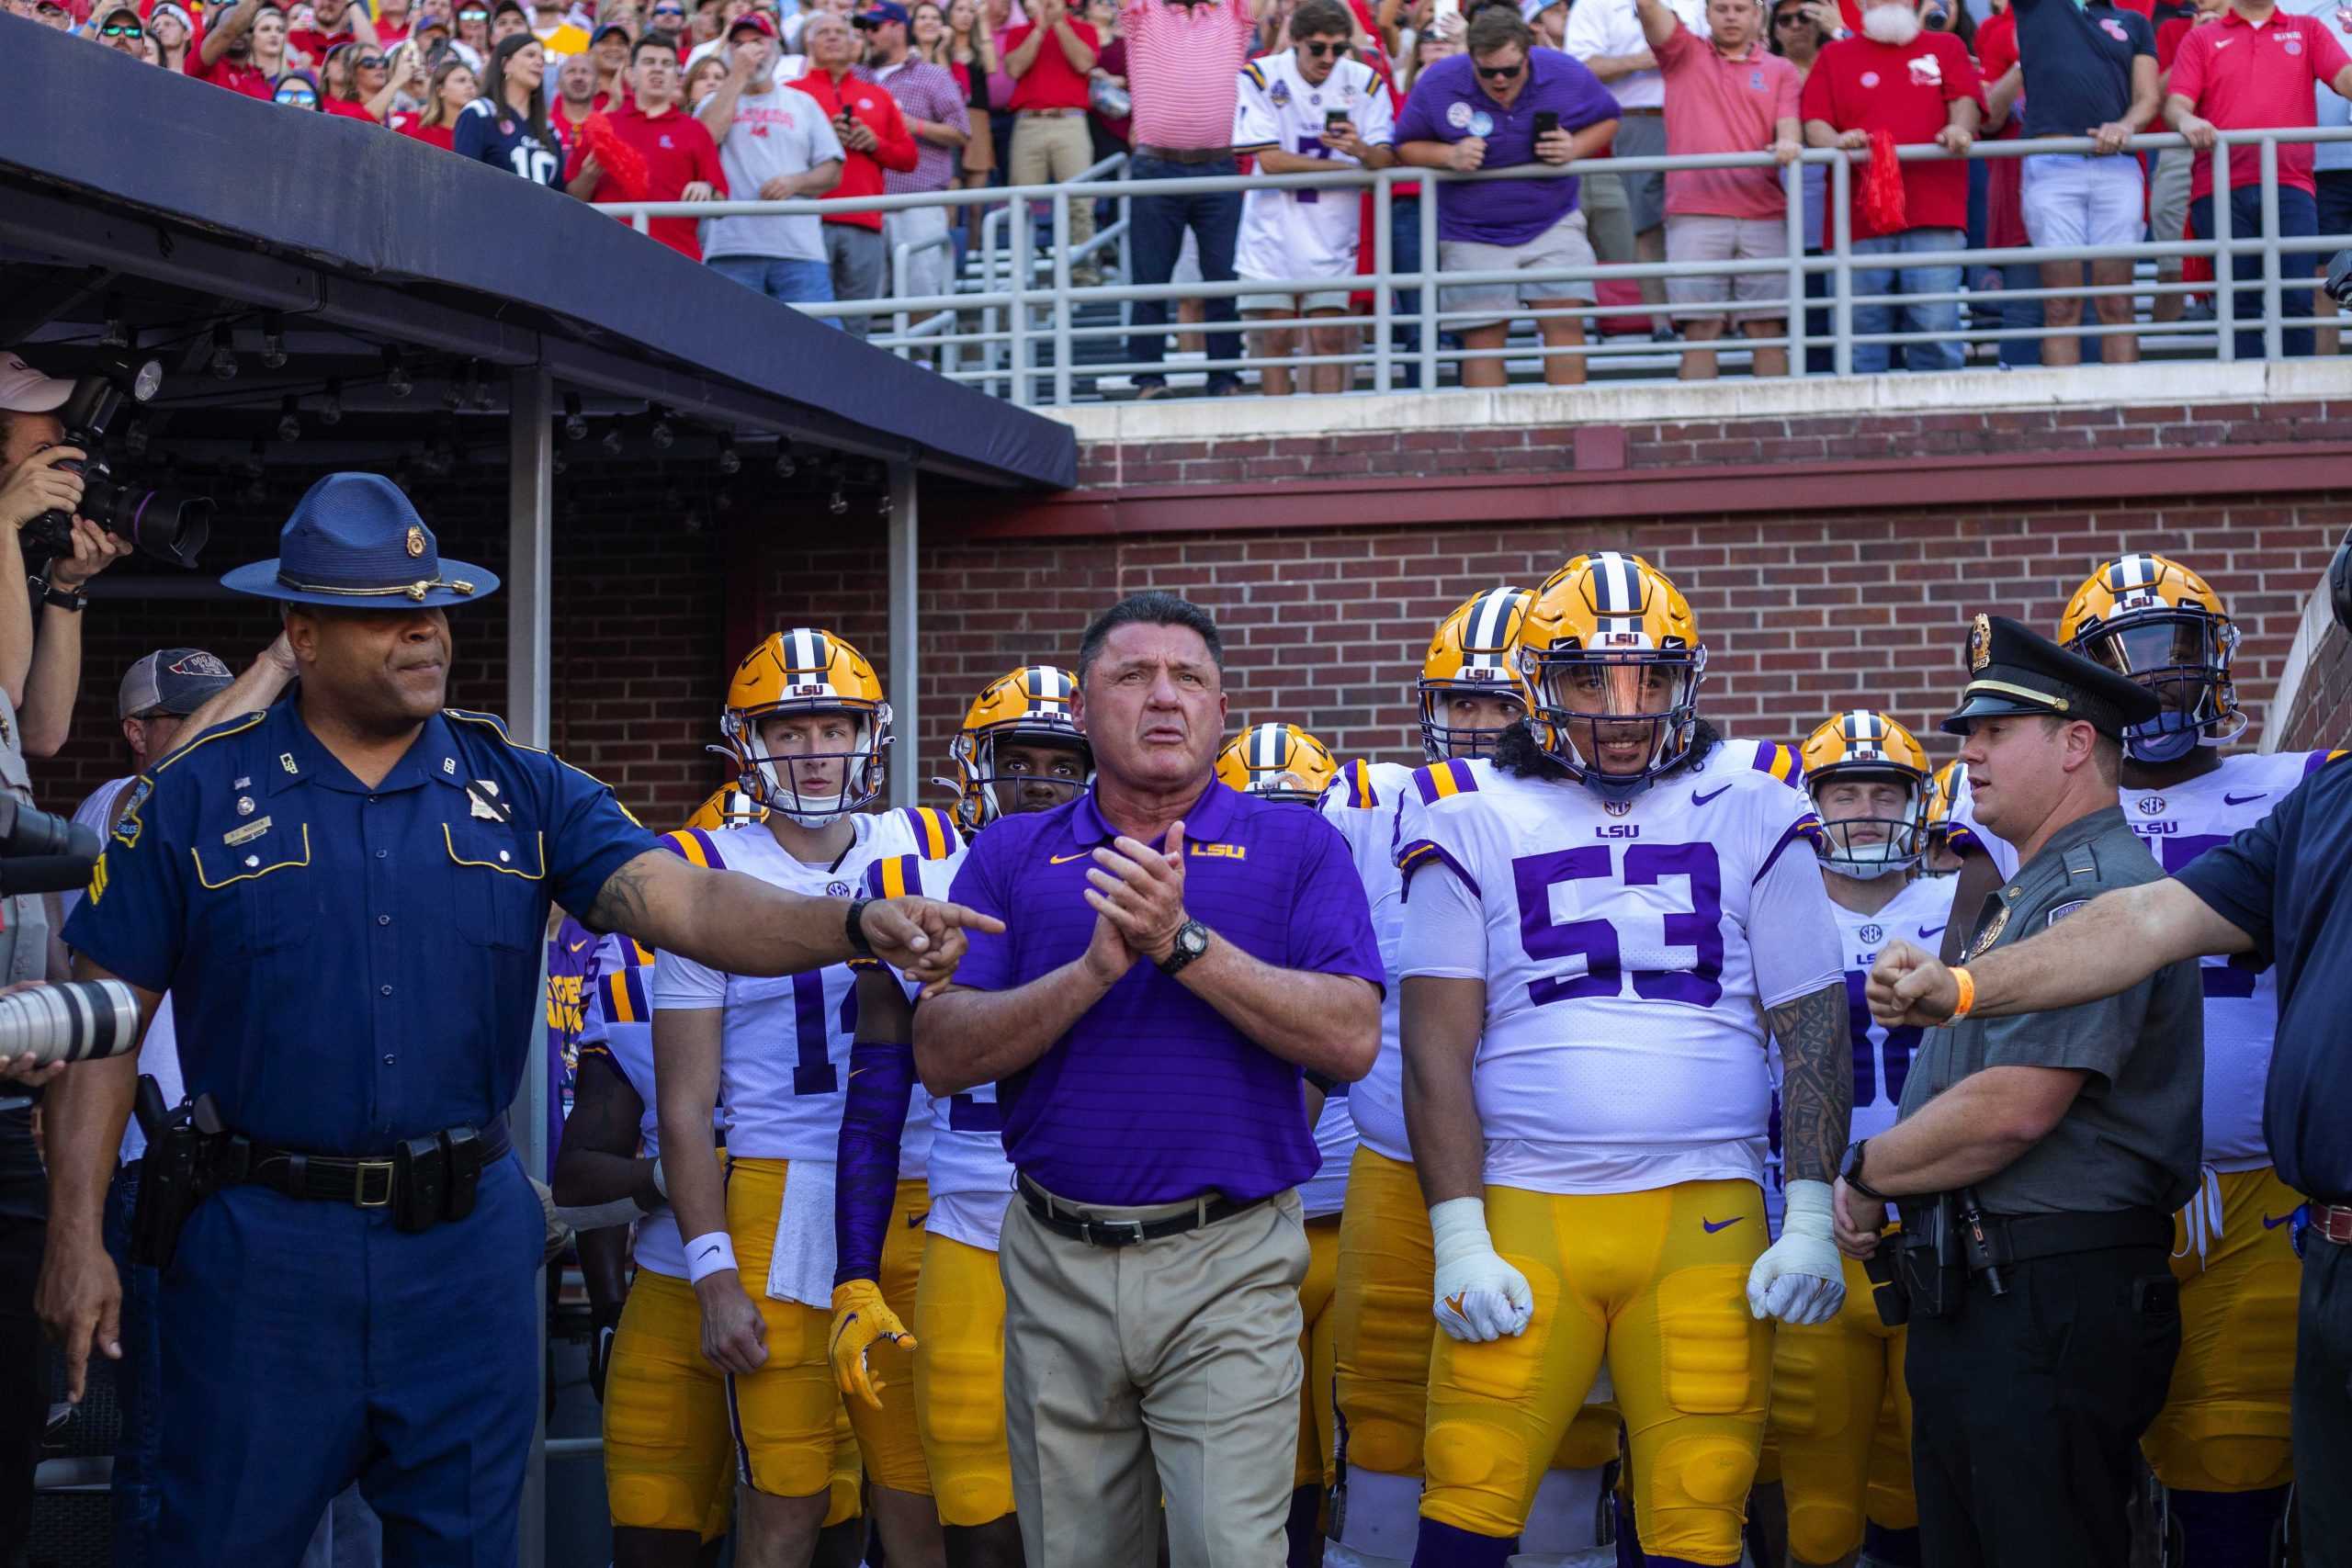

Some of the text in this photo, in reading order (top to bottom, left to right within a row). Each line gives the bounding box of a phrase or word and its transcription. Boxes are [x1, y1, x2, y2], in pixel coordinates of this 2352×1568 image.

[2121, 595, 2154, 612] LSU
[1605, 633, 1639, 647] LSU
[1464, 668, 1495, 680] LSU
[793, 684, 824, 696] LSU
[1851, 750, 1879, 761] LSU
[2140, 797, 2165, 815] SEC
[1596, 825, 1639, 838] LSU
[2133, 821, 2177, 834] LSU
[1191, 842, 1246, 859] LSU
[1511, 841, 1724, 1008] 53
[1860, 925, 1883, 943] SEC
[1856, 953, 1877, 964] LS
